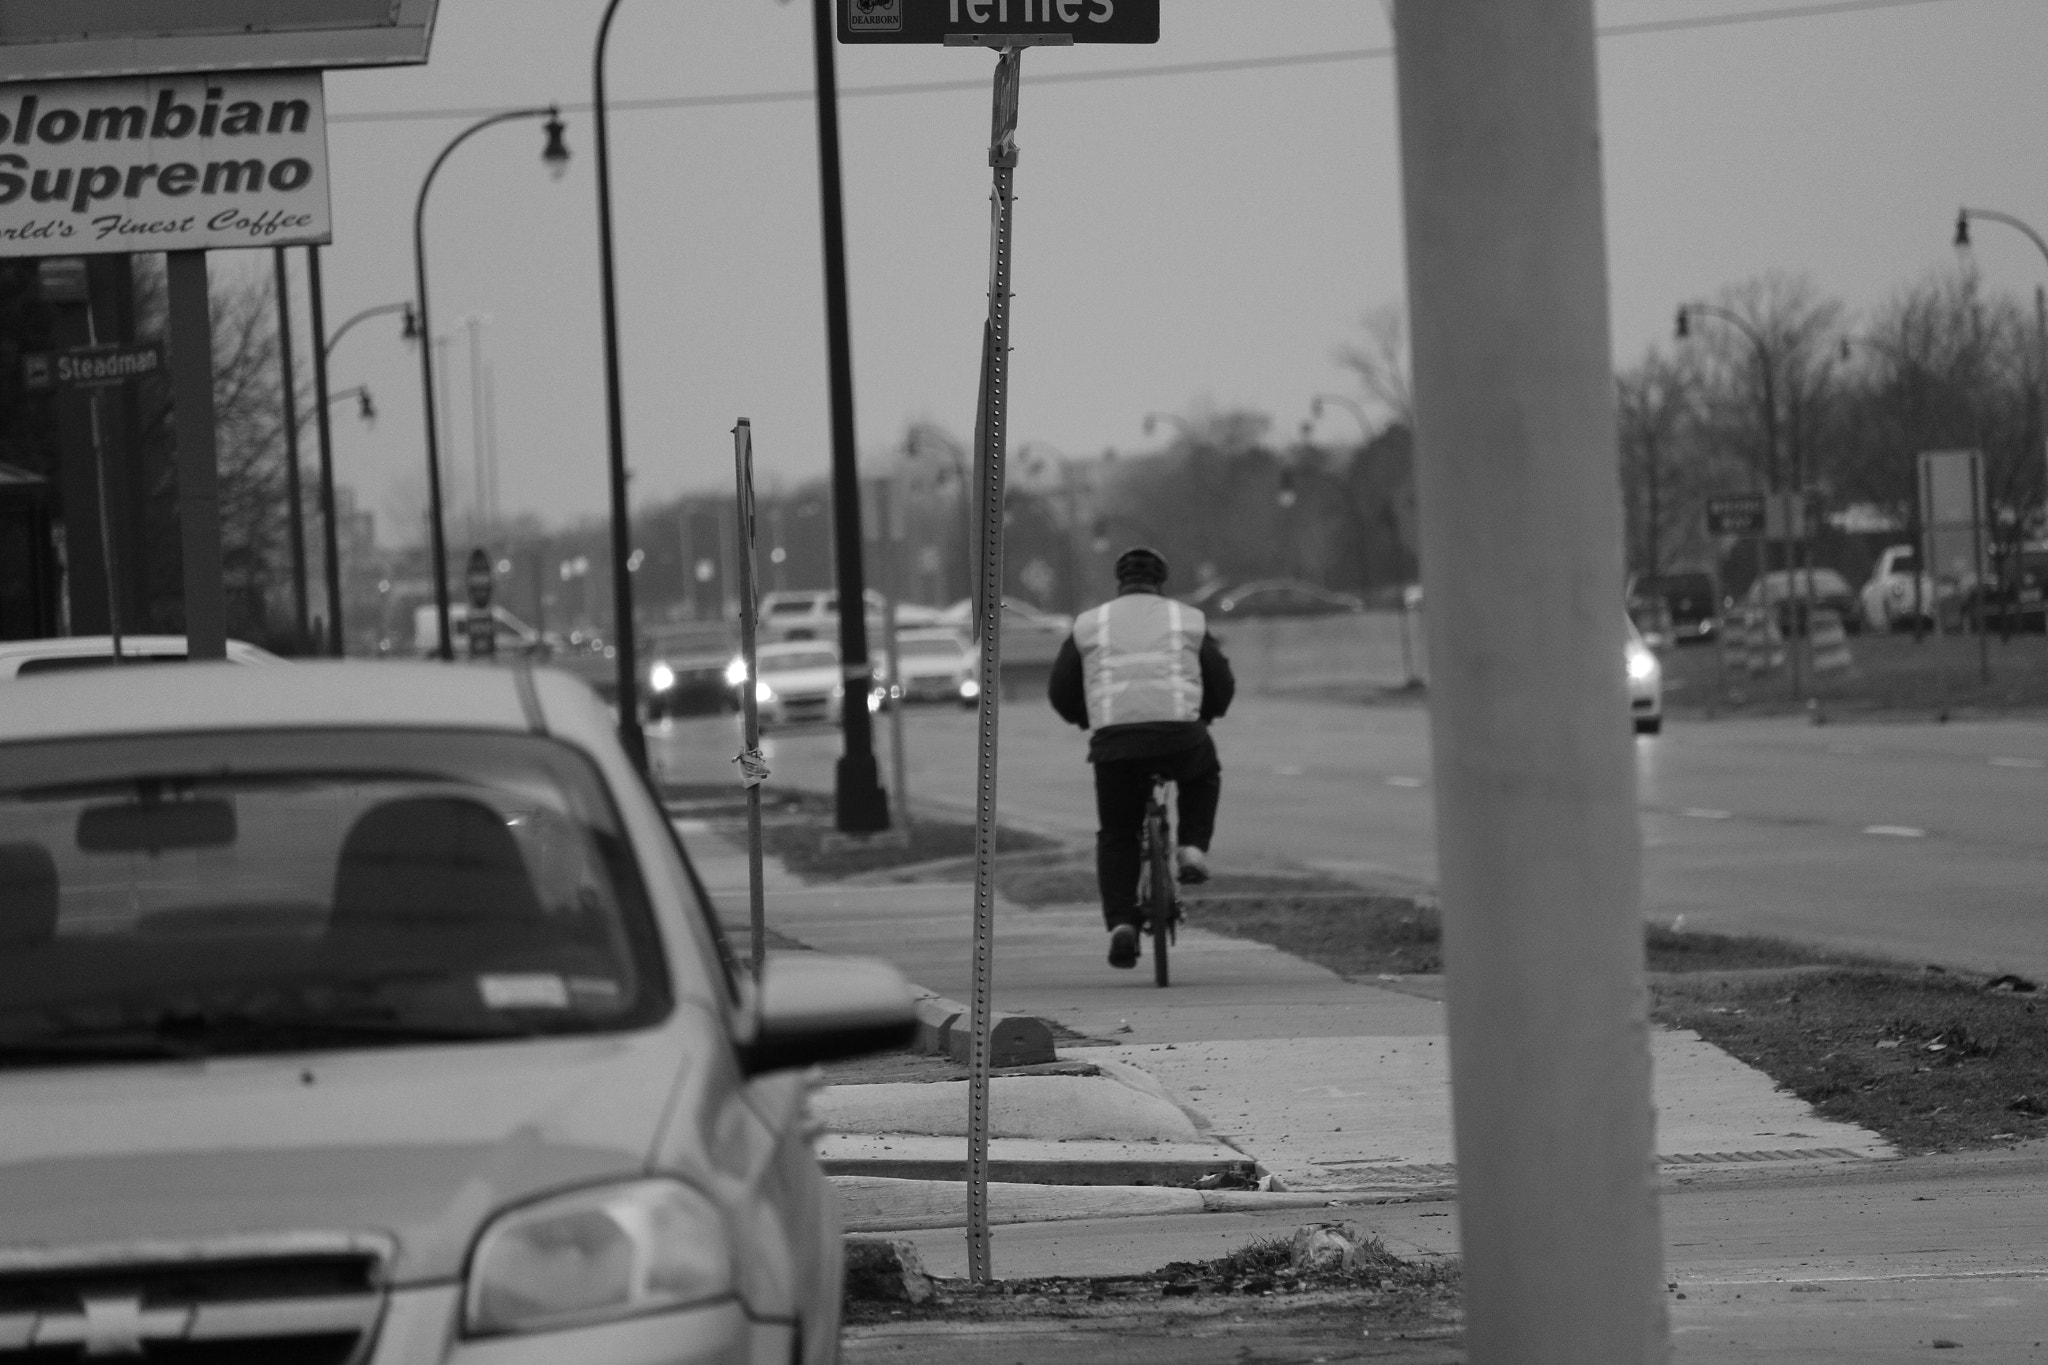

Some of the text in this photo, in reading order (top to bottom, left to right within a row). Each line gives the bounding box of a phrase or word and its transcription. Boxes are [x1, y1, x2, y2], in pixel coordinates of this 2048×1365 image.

[851, 15, 899, 25] DEARBORN
[0, 87, 311, 145] lombian
[0, 153, 313, 214] Supremo
[0, 208, 313, 240] rld's Finest Coffee
[57, 349, 157, 381] Steadman
